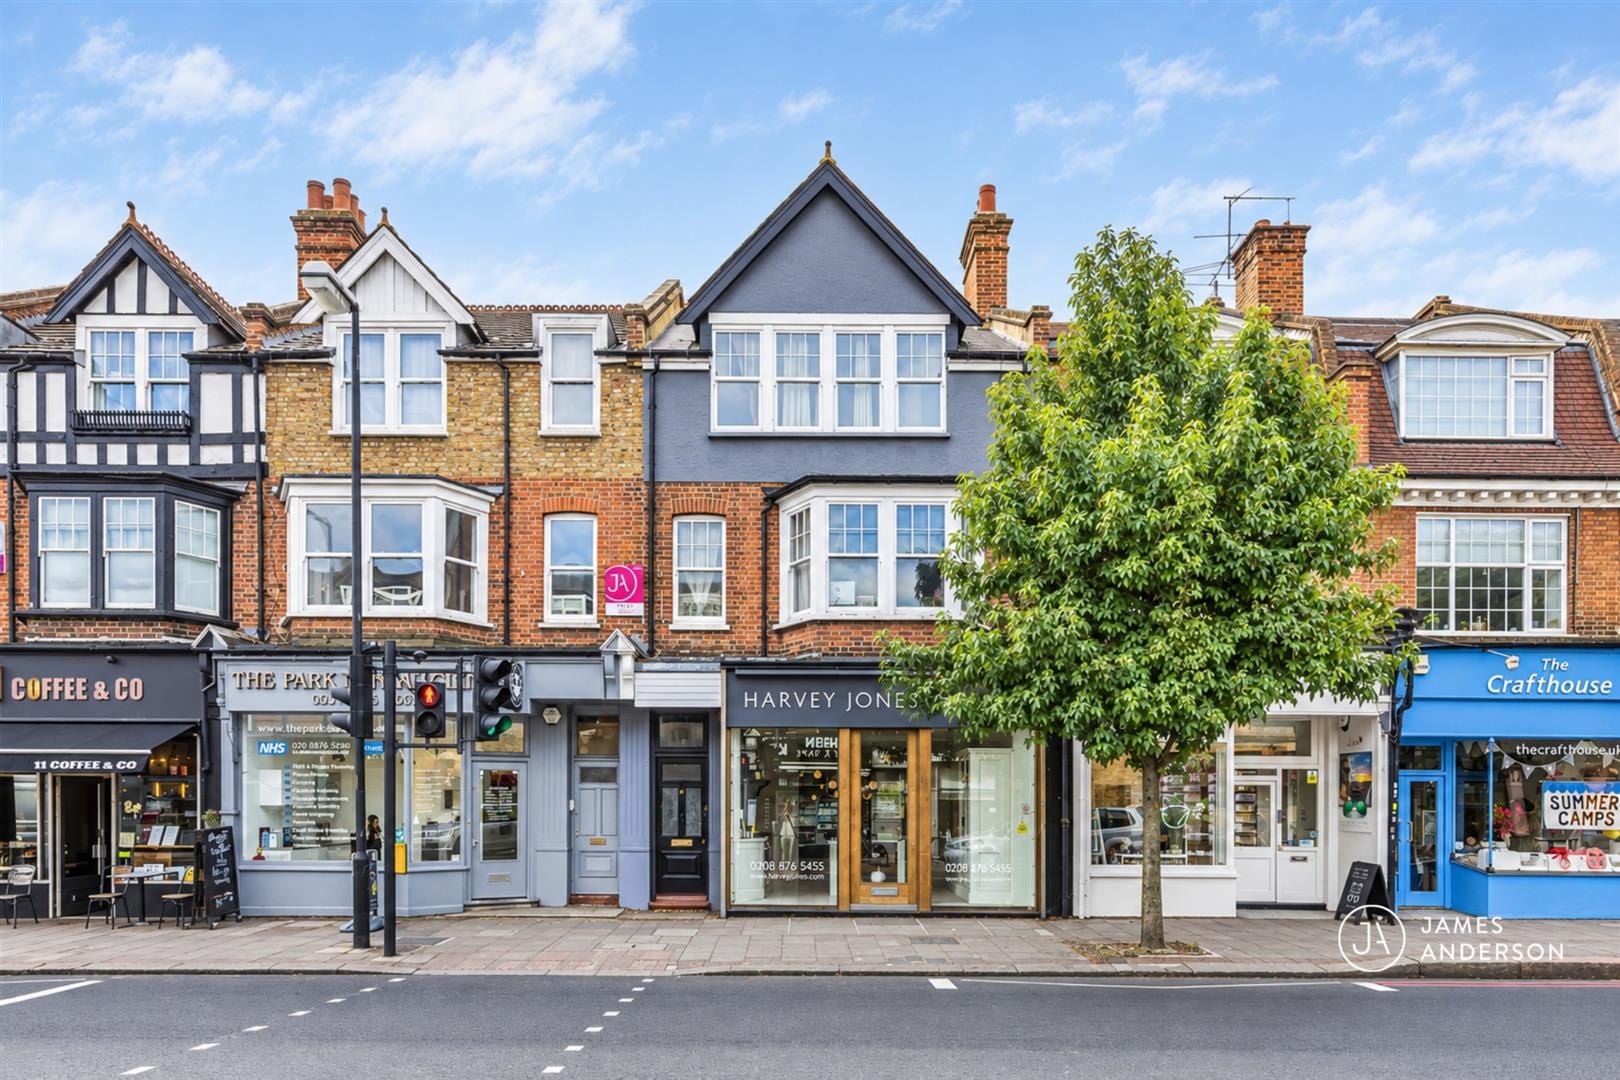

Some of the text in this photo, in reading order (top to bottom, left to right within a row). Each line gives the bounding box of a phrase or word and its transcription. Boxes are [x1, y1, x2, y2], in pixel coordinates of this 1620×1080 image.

[1542, 658, 1569, 671] The
[232, 671, 275, 690] THE
[283, 671, 337, 690] PARK
[1487, 674, 1613, 694] Crafthouse
[11, 677, 145, 701] COFFEE & CO
[744, 692, 918, 712] HARVEY JONES
[260, 743, 285, 753] NHS
[34, 761, 47, 769] 11
[50, 761, 101, 769] COFFEE
[116, 761, 137, 769] CO
[1550, 795, 1619, 810] SUMMER
[1558, 811, 1615, 826] CAMPS
[751, 861, 825, 871] 0208 876 5455
[945, 863, 968, 873] 0208
